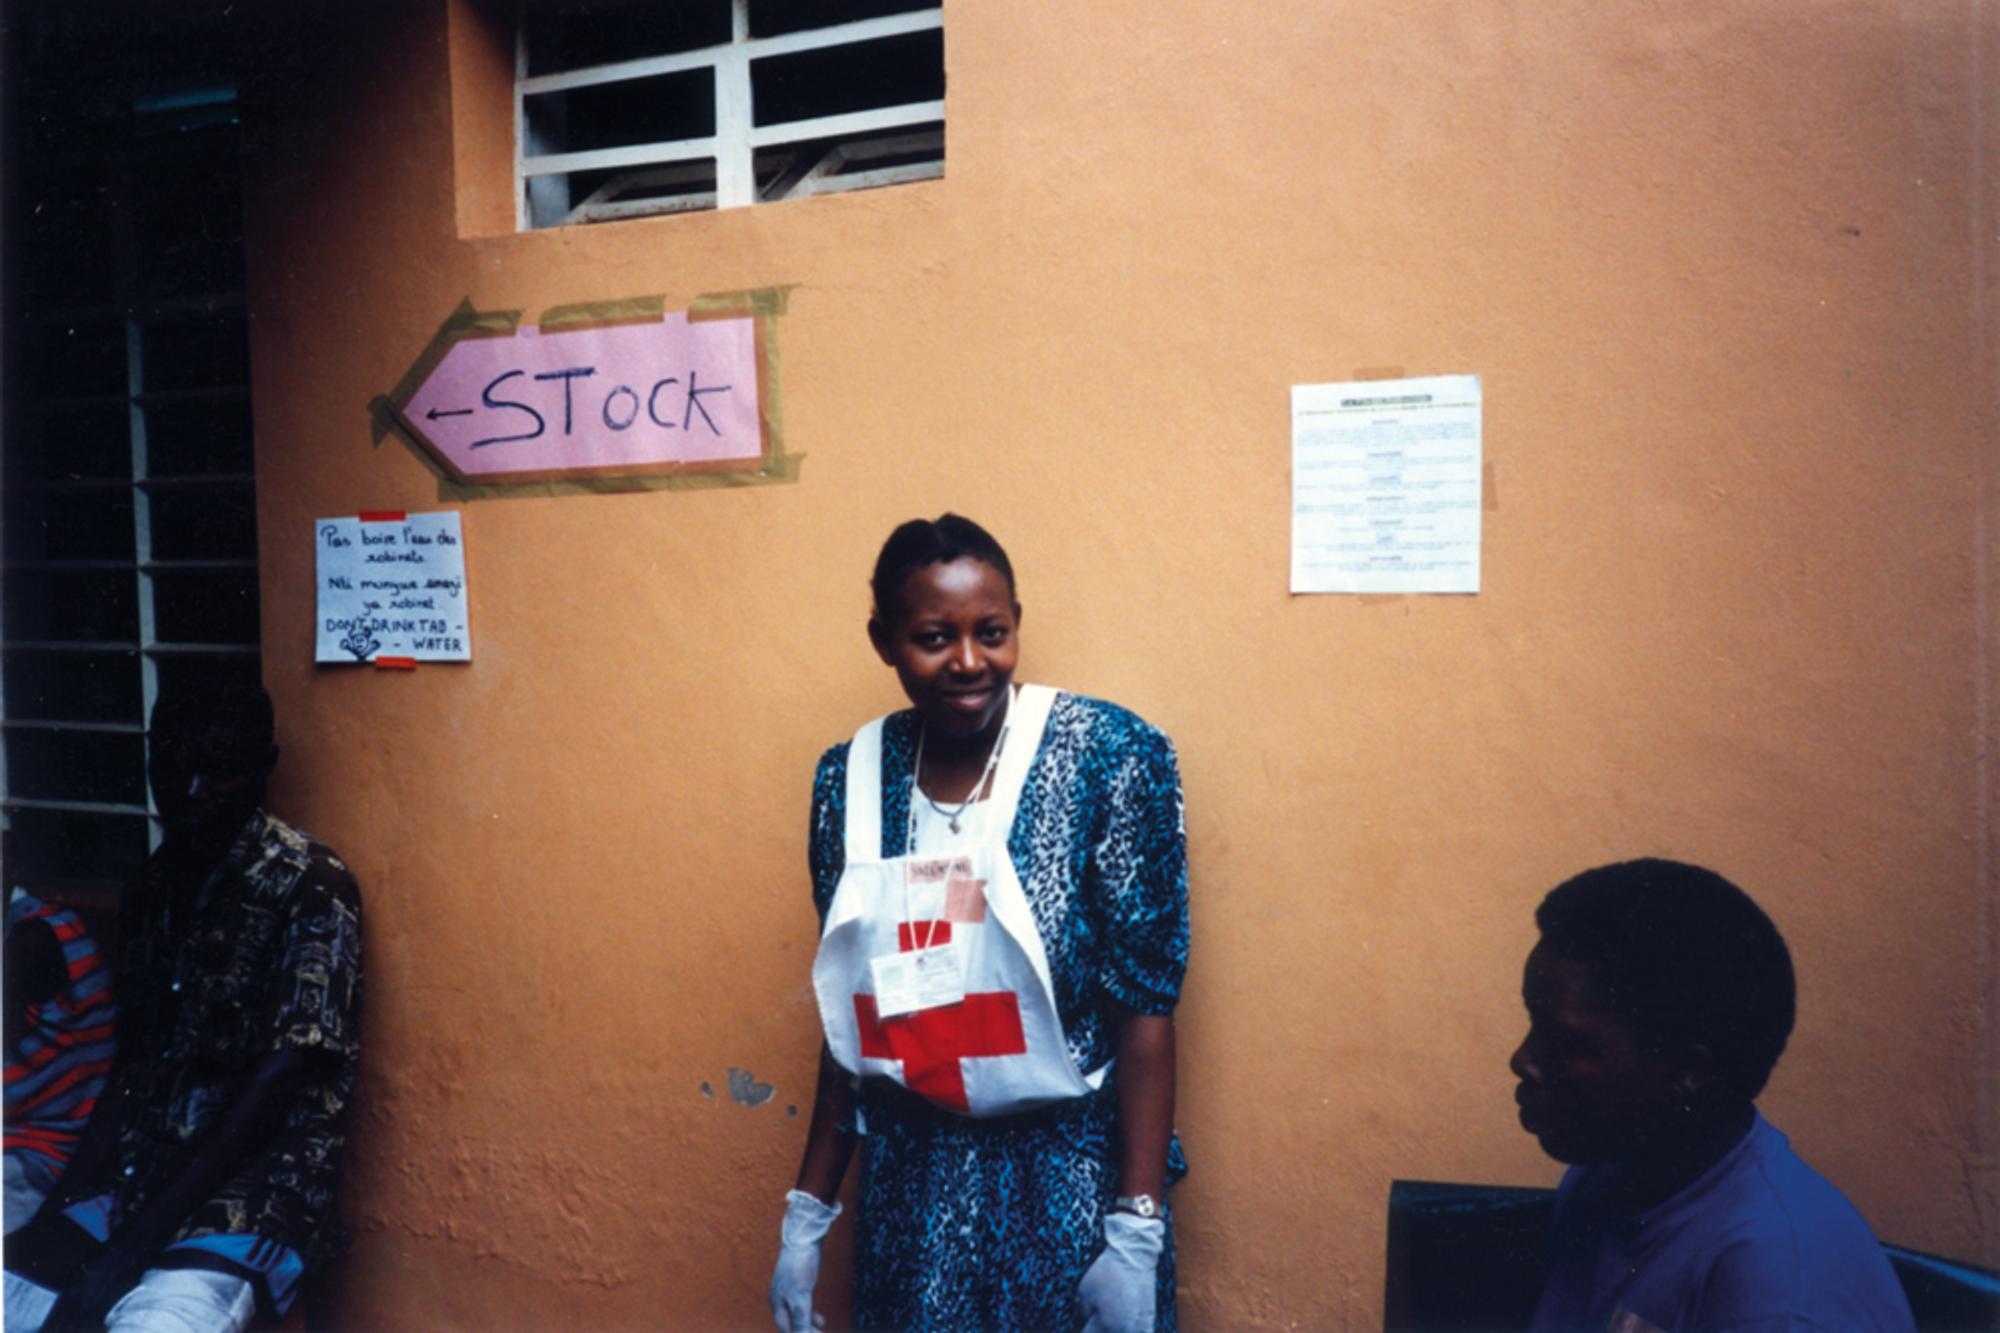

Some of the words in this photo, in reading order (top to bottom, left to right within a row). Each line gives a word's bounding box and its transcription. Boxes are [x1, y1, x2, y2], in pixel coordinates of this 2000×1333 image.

[469, 367, 732, 450] STOCK
[320, 525, 351, 547] Pas
[361, 529, 397, 545] boire
[371, 618, 416, 633] DRINK
[418, 619, 447, 633] TAB
[413, 638, 462, 651] WATER
